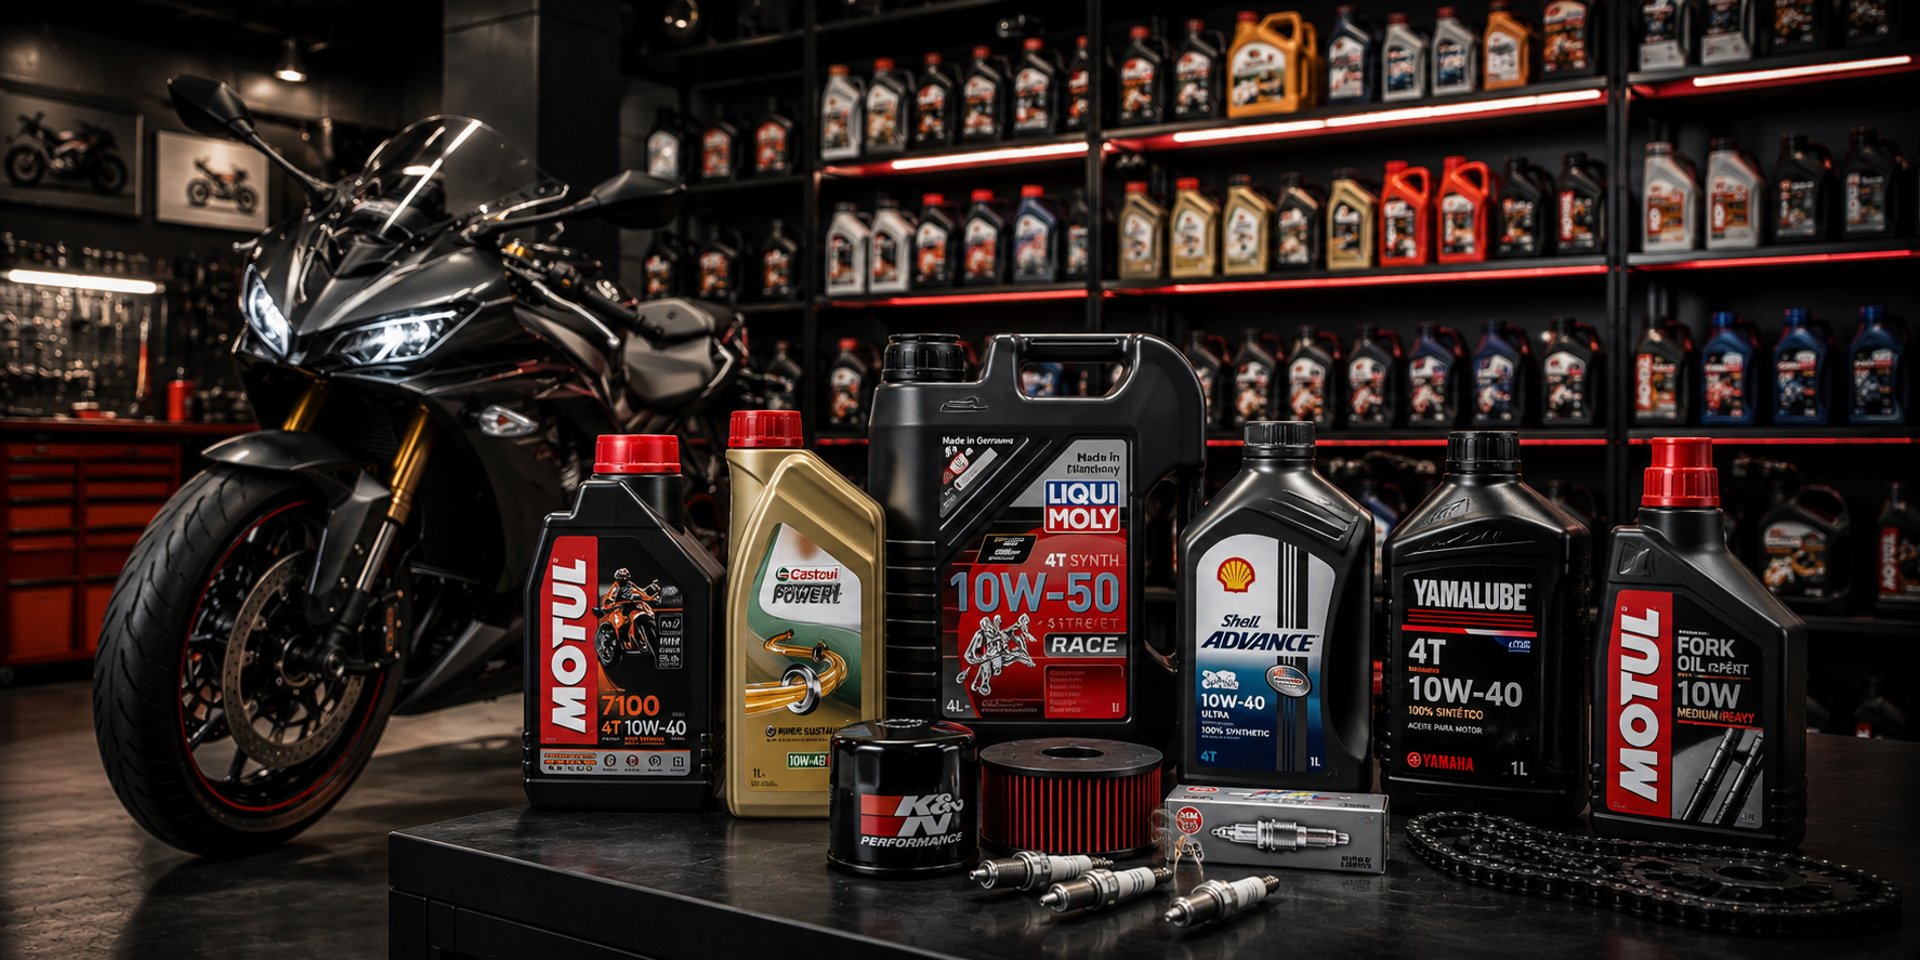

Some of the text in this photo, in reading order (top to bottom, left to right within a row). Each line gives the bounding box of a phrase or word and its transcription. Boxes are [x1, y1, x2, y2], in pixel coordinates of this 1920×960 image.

[1109, 452, 1120, 462] in
[1048, 482, 1116, 506] LIQUI
[1048, 508, 1117, 530] MOLY
[1044, 552, 1120, 567] 4T SYNTH
[950, 571, 1120, 613] 10W-50
[1413, 578, 1527, 612] YAMALUBE
[1221, 614, 1261, 629] Shell
[552, 557, 588, 734] MOTUL
[1051, 636, 1120, 654] RACE
[1200, 631, 1317, 653] ADVANCE
[1677, 636, 1736, 658] FORK
[1408, 638, 1447, 666] 4T
[1677, 655, 1706, 672] OIL
[1408, 675, 1523, 708] 10W-40
[1677, 680, 1741, 709] 10W
[601, 694, 660, 717] 7100
[1200, 693, 1266, 711] 10W-40
[1408, 705, 1434, 717] 100%
[1619, 608, 1661, 803] MOTUL
[601, 719, 687, 736] 4T 10W-40
[1201, 725, 1224, 736] 100%
[1200, 750, 1218, 763] 4T
[1310, 756, 1321, 767] 1L
[1423, 753, 1475, 772] YAMAHA
[1511, 760, 1528, 776] 1L
[894, 792, 965, 838] K&N
[860, 831, 964, 848] PERFORMANCE
